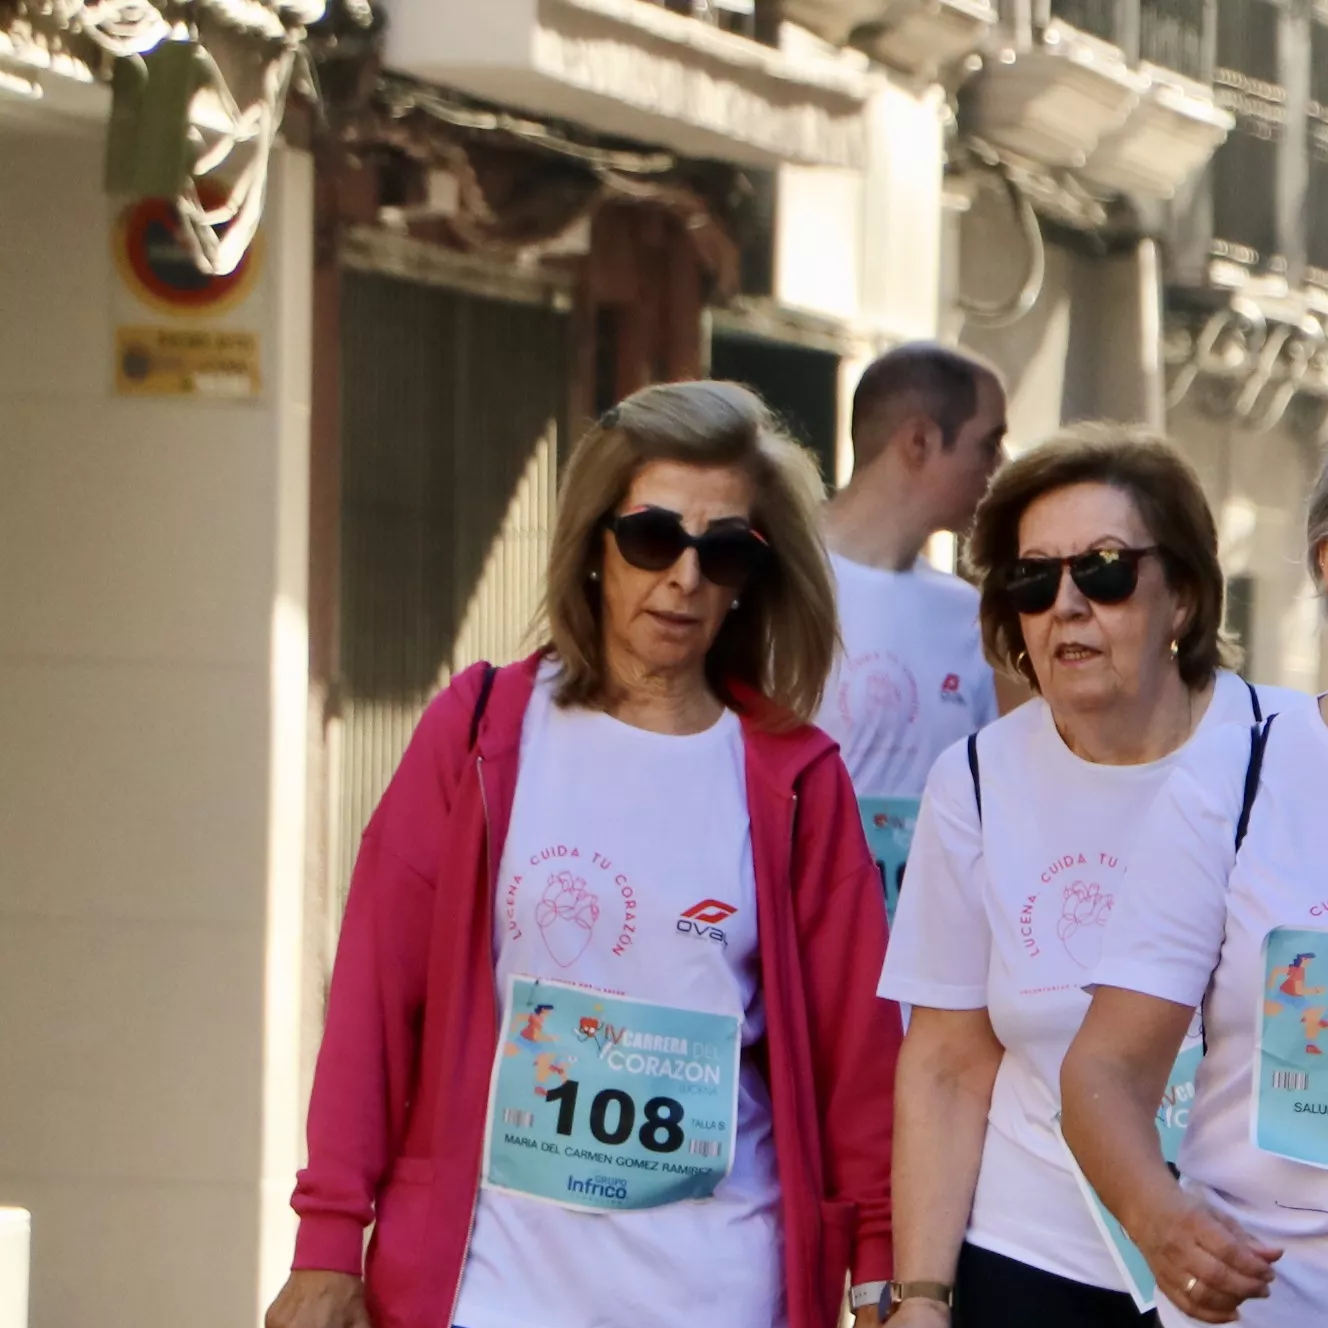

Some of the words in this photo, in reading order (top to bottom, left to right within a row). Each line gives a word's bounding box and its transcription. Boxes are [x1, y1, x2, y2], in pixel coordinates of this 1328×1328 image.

[506, 874, 523, 941] LUCENA
[530, 845, 580, 866] CUIDA
[592, 852, 612, 870] TU
[612, 874, 637, 957] CORAZÓN
[1020, 894, 1040, 957] LUCENA
[1041, 853, 1087, 883] CUIDA
[1100, 853, 1119, 868] TU
[605, 1023, 626, 1044] IV
[623, 1030, 688, 1056] CARRERA
[693, 1042, 720, 1060] DEL
[546, 1080, 685, 1154] 108
[691, 1118, 716, 1131] TALLA
[504, 1133, 538, 1150] MARIA
[541, 1141, 561, 1154] DEL
[565, 1146, 613, 1164] CARMEN
[615, 1155, 659, 1171] GOMEZ
[567, 1175, 627, 1200] Infrico
[595, 1174, 627, 1187] GRUPO
